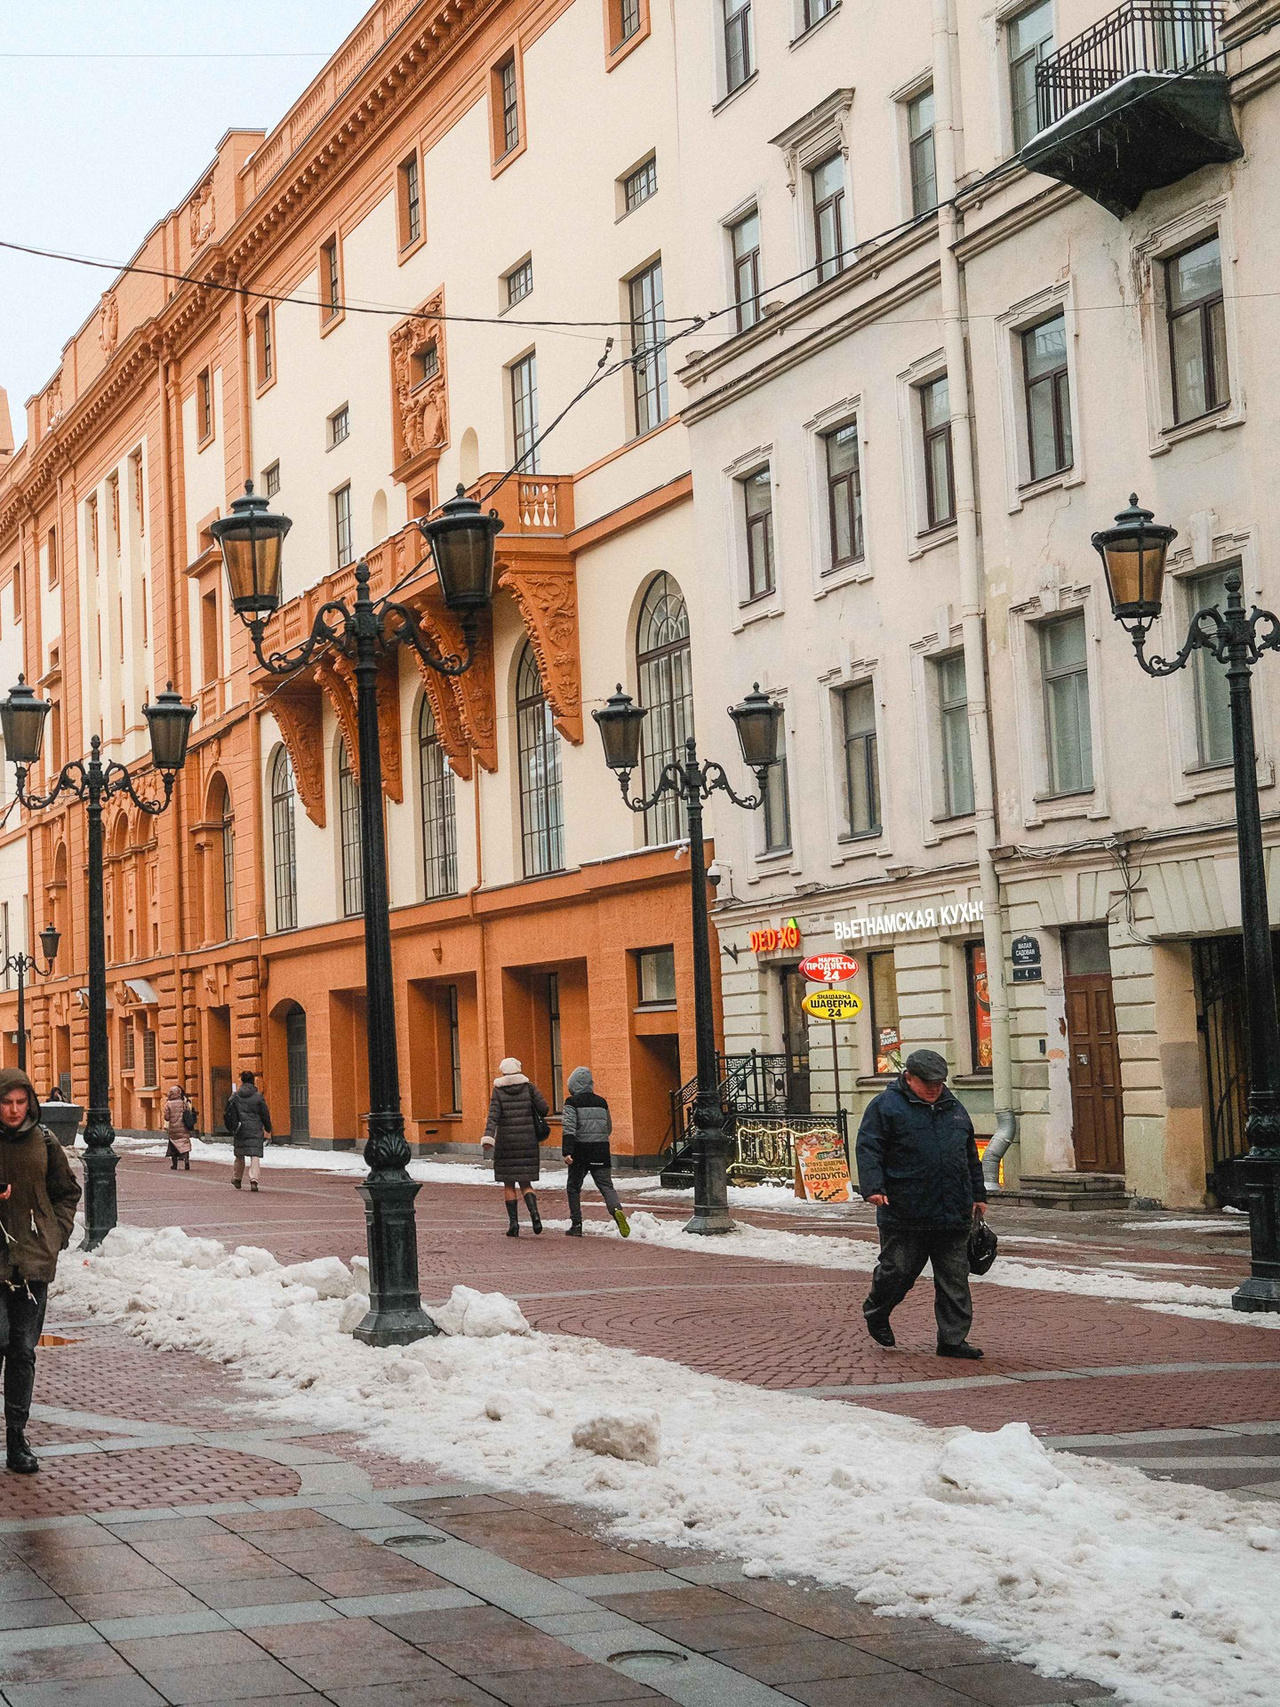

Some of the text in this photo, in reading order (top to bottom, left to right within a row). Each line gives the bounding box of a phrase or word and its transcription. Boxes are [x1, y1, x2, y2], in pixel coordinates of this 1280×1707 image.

[834, 908, 935, 940] ВЬЕТНАМСКАЯ
[806, 962, 856, 971] ПРОДУКТЫ
[824, 971, 840, 980] 24
[810, 1000, 859, 1009] ШАВЕРМА
[828, 1009, 842, 1018] 24
[804, 1172, 849, 1180] ПРОДУКТЫ
[813, 1181, 830, 1190] 24
